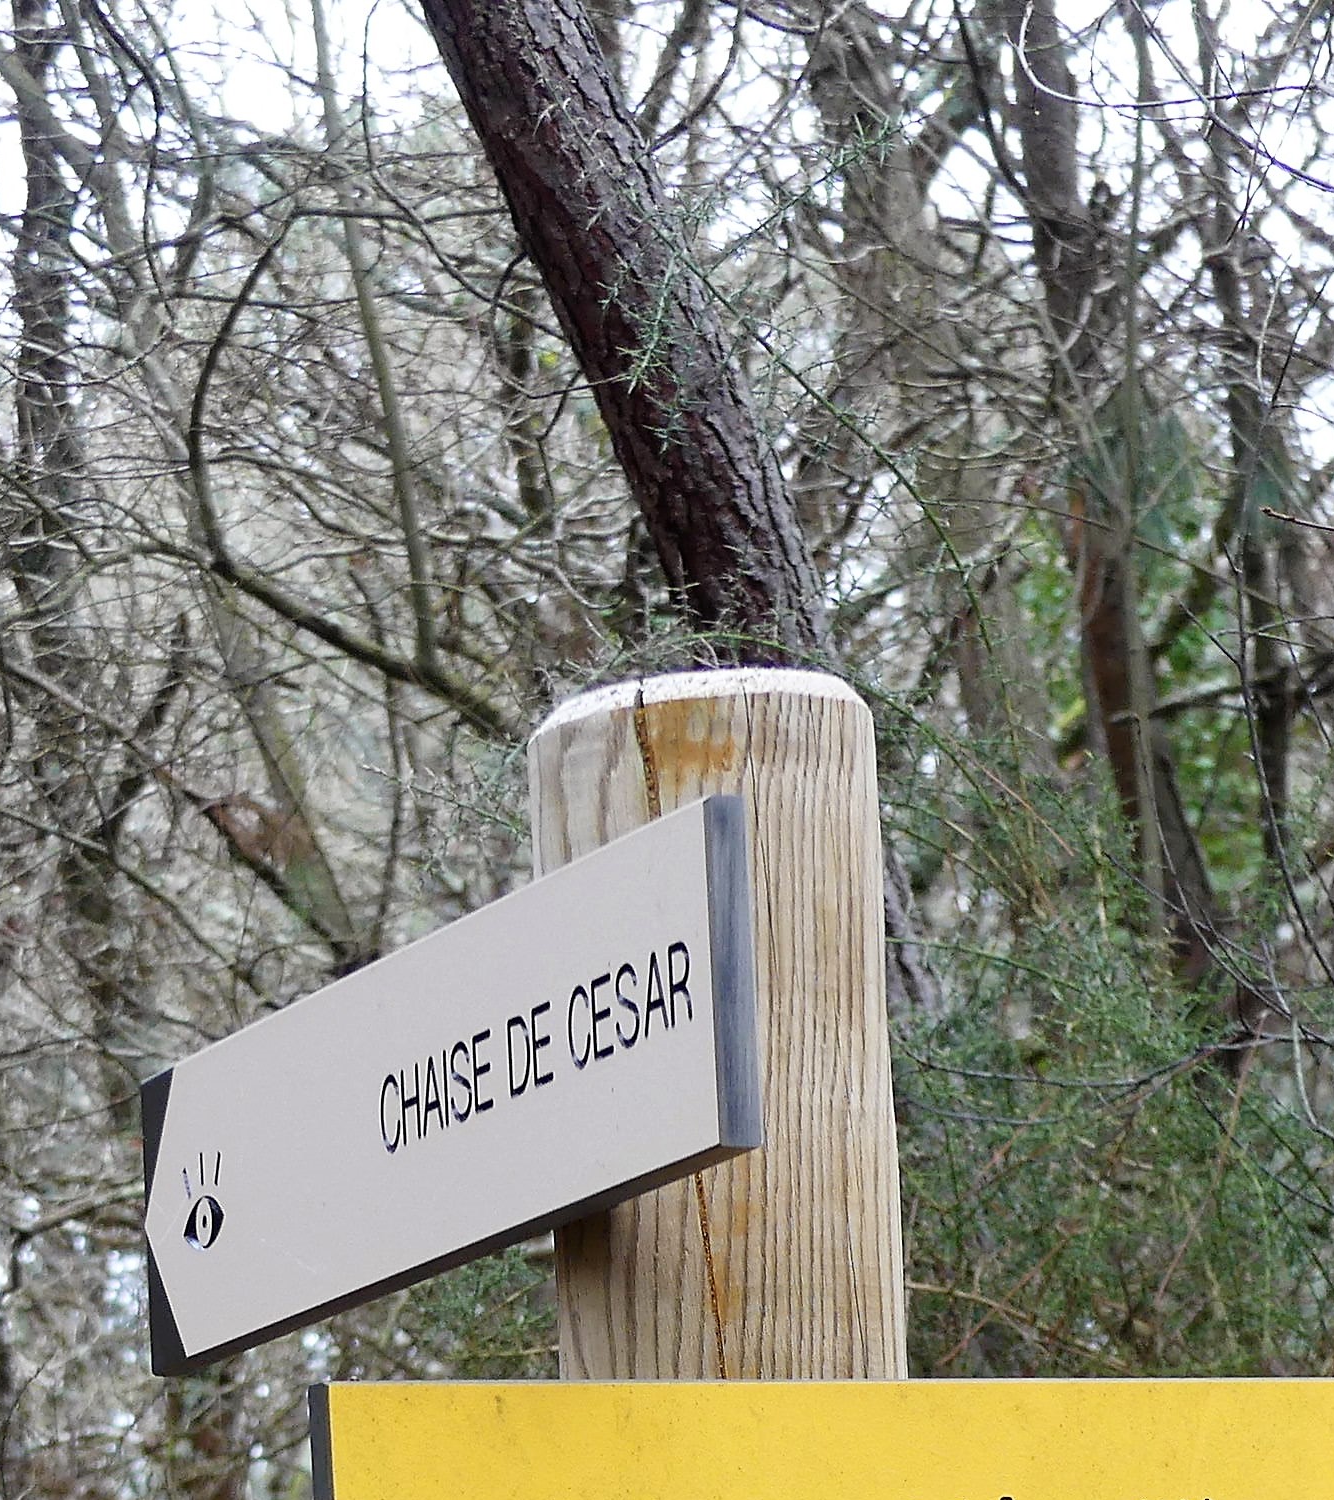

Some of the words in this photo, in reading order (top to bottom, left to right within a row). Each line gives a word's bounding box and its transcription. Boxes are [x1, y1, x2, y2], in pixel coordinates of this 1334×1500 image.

[379, 1028, 495, 1155] CHAISE
[505, 1000, 555, 1100] DE
[566, 940, 694, 1071] CESAR
